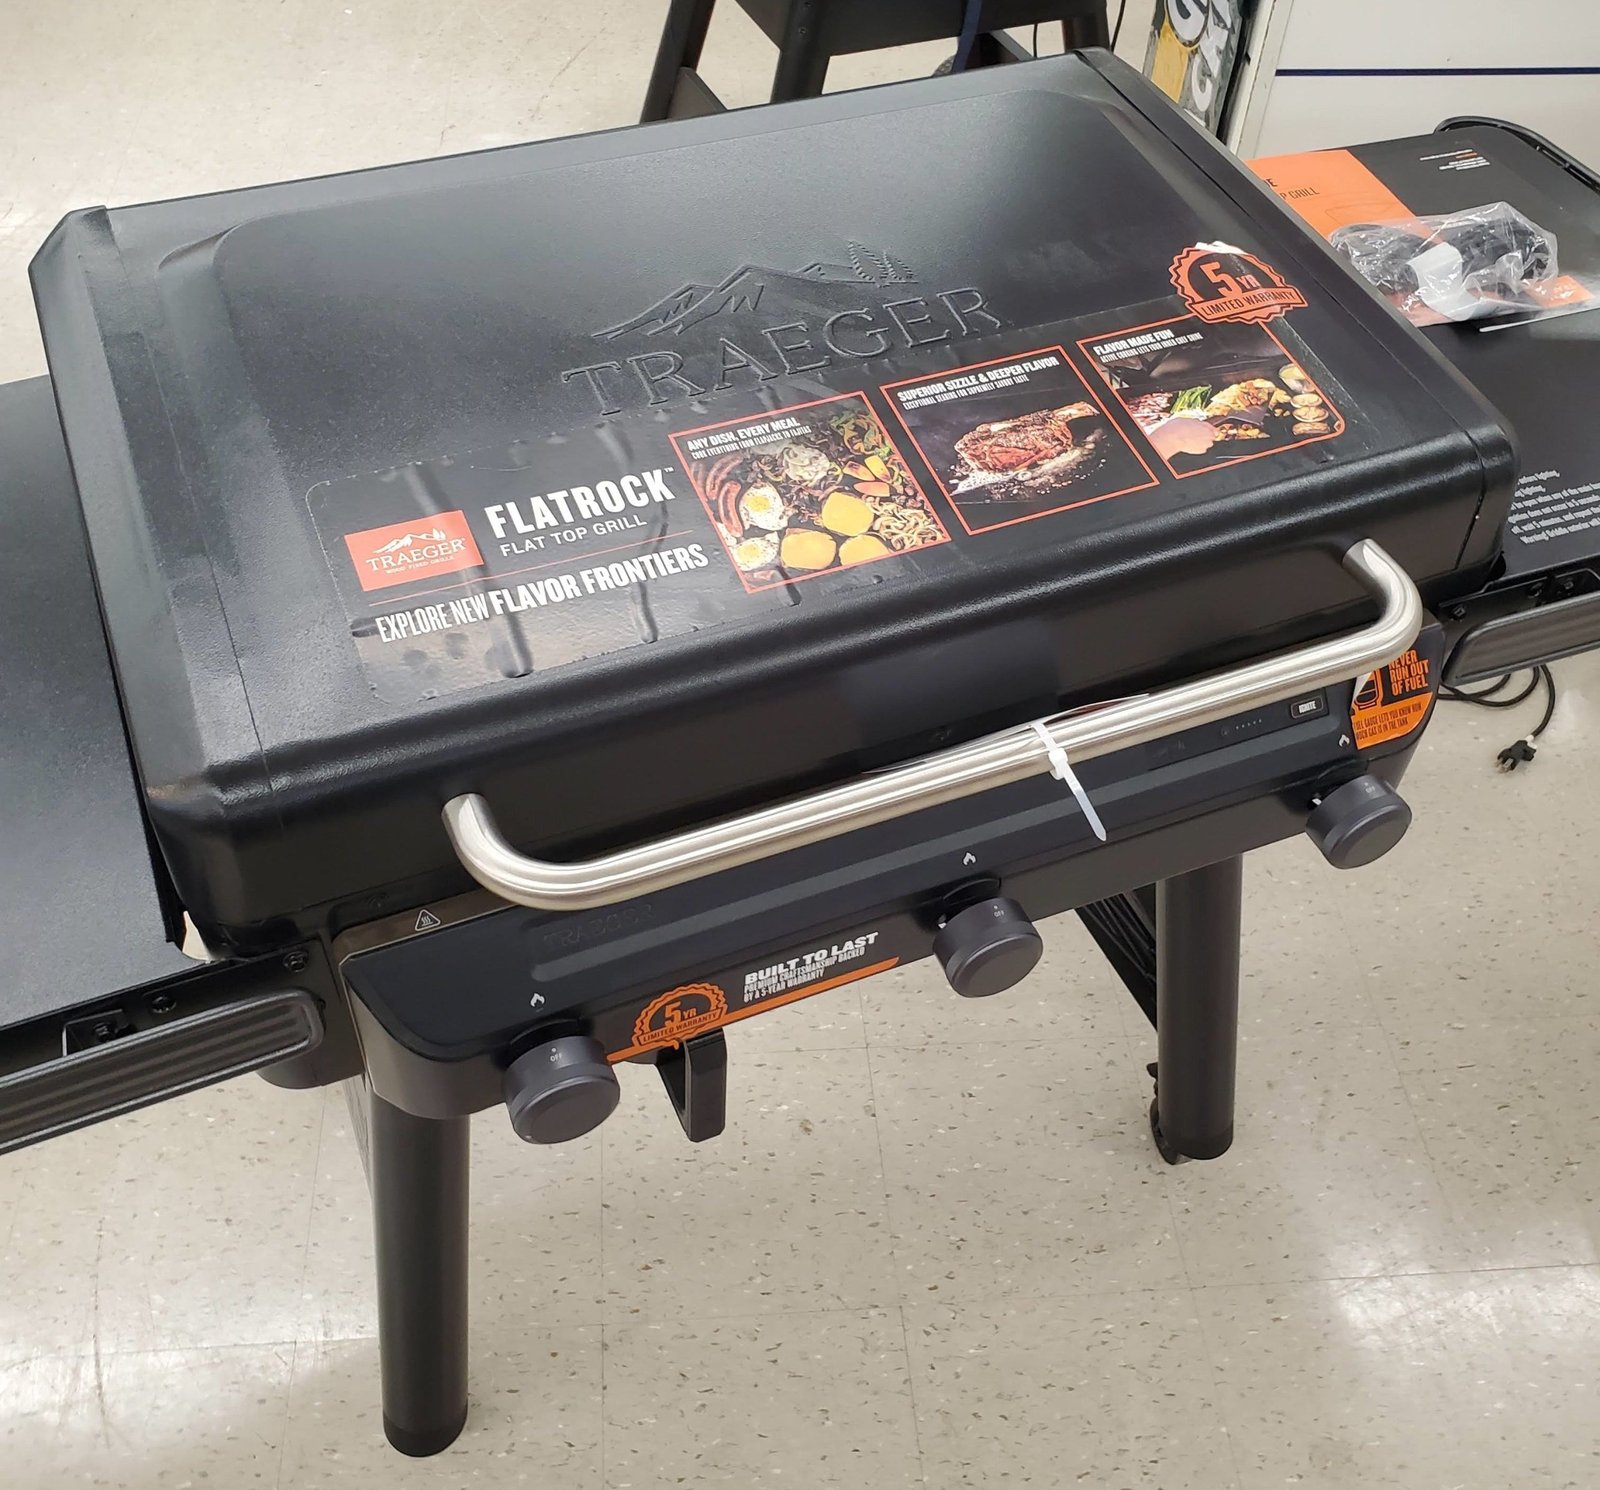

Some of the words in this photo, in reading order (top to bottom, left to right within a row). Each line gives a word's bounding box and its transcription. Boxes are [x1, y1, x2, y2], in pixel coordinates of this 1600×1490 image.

[1200, 261, 1242, 298] 5
[1235, 274, 1261, 289] YR
[1200, 299, 1245, 316] LIMITED
[1244, 291, 1295, 305] WARRANTY
[561, 286, 1003, 416] TRAEGER
[1093, 340, 1130, 356] FLAVOR
[1127, 333, 1156, 347] MADE
[1153, 329, 1175, 341] FUN
[897, 383, 947, 402] SUPERIOR
[944, 374, 977, 391] SIZZLE
[977, 372, 989, 384] &
[987, 364, 1025, 382] DEEPER
[1023, 356, 1060, 373] FLAVOR
[687, 439, 709, 452] ANY
[709, 431, 739, 446] DISH,
[737, 424, 771, 439] EVERY
[770, 417, 801, 432] MEAL
[484, 469, 676, 539] FLATROCK
[500, 535, 545, 557] FLAT
[550, 527, 587, 545] TOP
[593, 514, 648, 537] GRILL
[375, 605, 451, 643] EXPLORE
[452, 596, 491, 625] NEW
[485, 574, 588, 615] FLAVOR
[584, 543, 709, 595] FRONTIERS
[1389, 665, 1409, 682] RUN
[1410, 660, 1429, 677] OUT
[1392, 681, 1403, 696] OF
[1404, 674, 1429, 692] FUEL
[744, 958, 800, 984] BUILT
[802, 949, 828, 965] TO
[831, 931, 879, 956] LAST
[643, 1028, 675, 1042] LIMITED
[676, 1012, 717, 1030] WARRANTY
[665, 1001, 681, 1028] 5
[683, 1008, 697, 1019] YR
